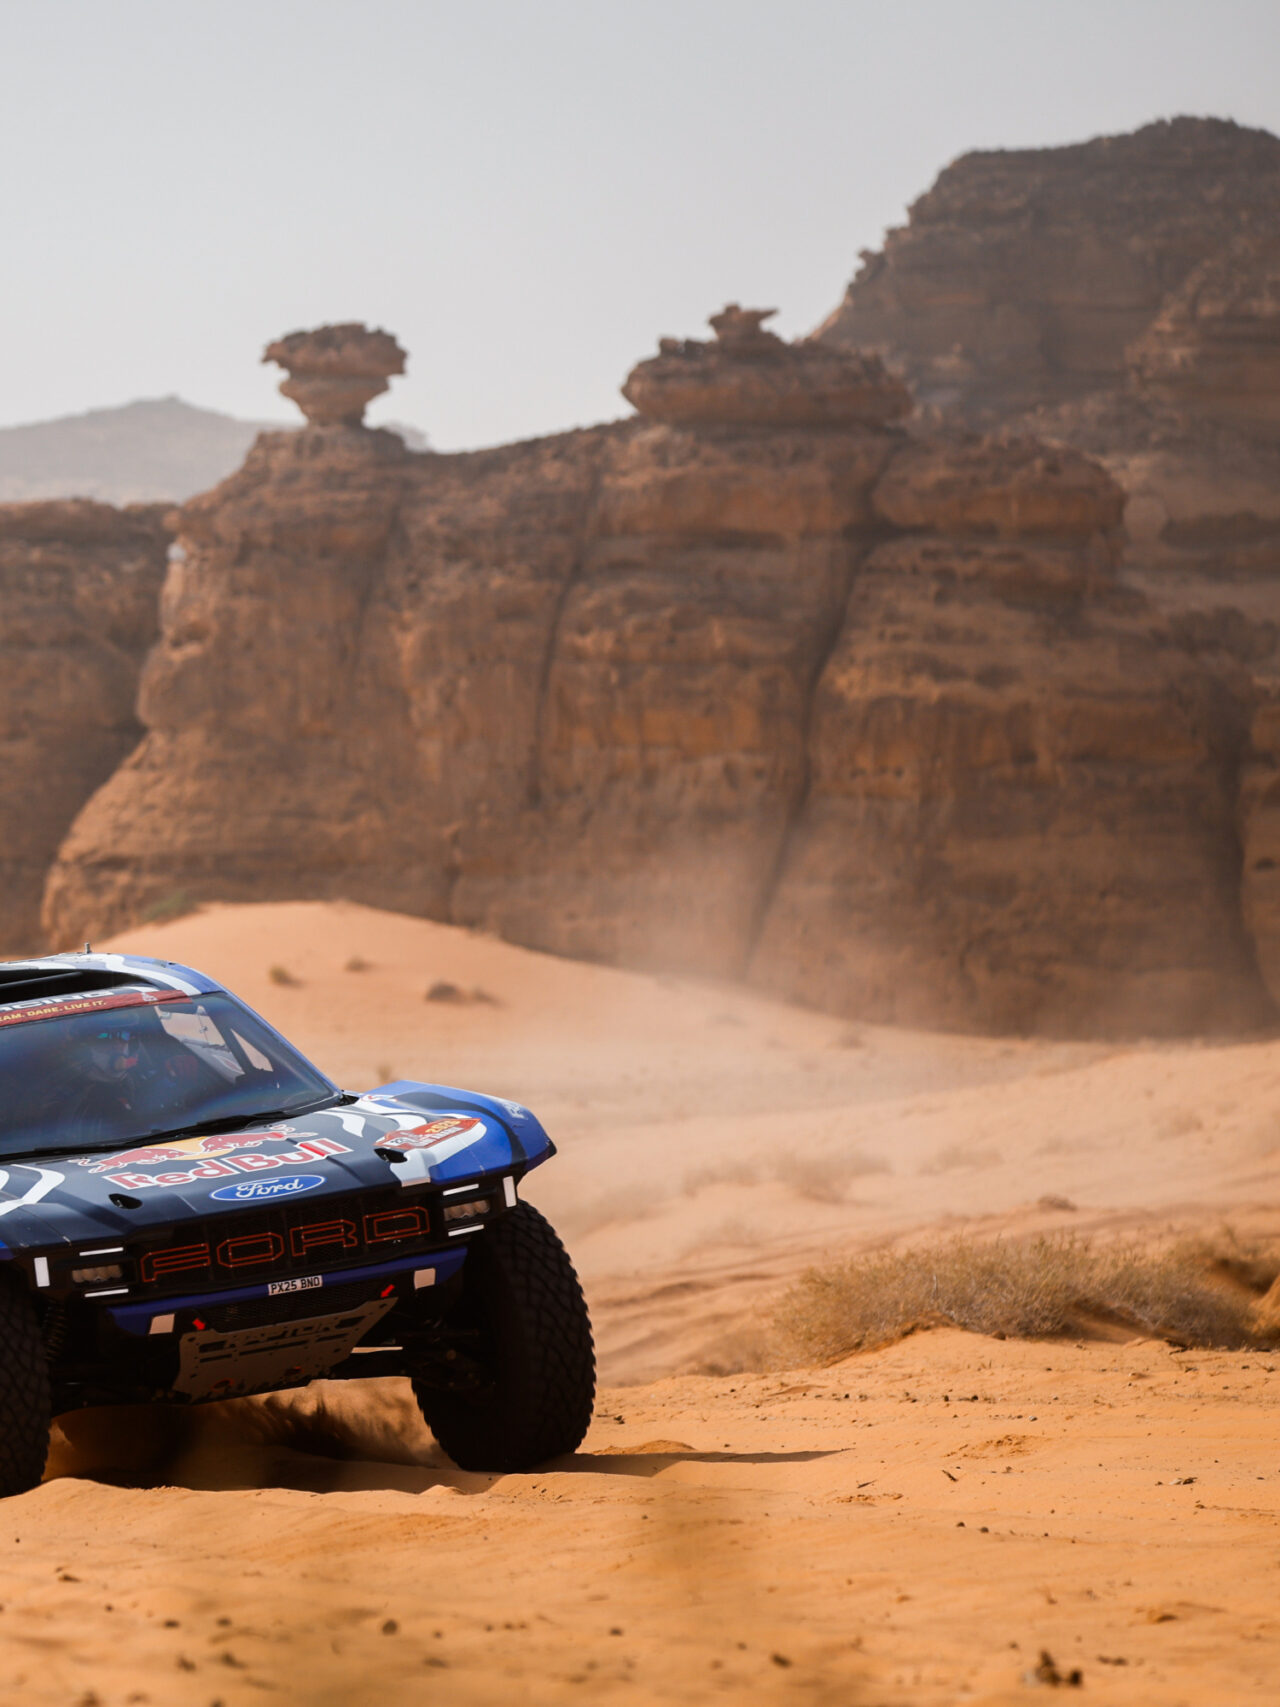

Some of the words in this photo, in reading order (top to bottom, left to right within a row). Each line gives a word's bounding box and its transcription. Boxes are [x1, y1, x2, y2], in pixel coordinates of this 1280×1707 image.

[27, 1006, 63, 1017] DARE.
[64, 1001, 91, 1011] LIVE
[93, 999, 107, 1007] IT.
[102, 1160, 240, 1190] Red
[222, 1138, 354, 1173] Bull
[235, 1178, 304, 1199] Ford
[140, 1206, 430, 1283] FORD
[270, 1280, 298, 1295] PX25
